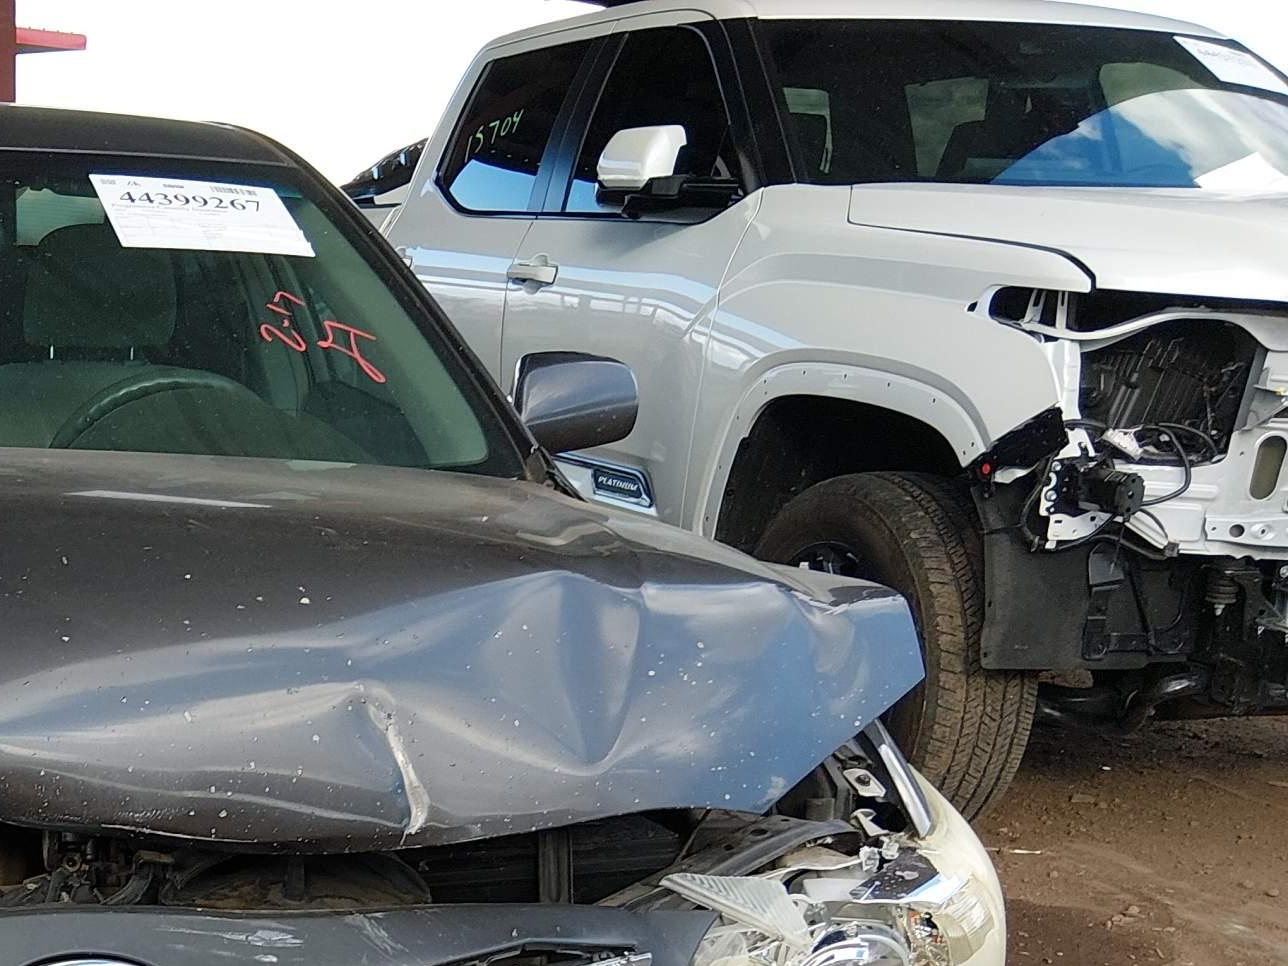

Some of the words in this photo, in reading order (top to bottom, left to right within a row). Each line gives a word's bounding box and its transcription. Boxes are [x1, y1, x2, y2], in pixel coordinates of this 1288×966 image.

[464, 108, 525, 163] 15704
[120, 191, 260, 212] 44399267
[598, 476, 638, 490] PLATINUM
